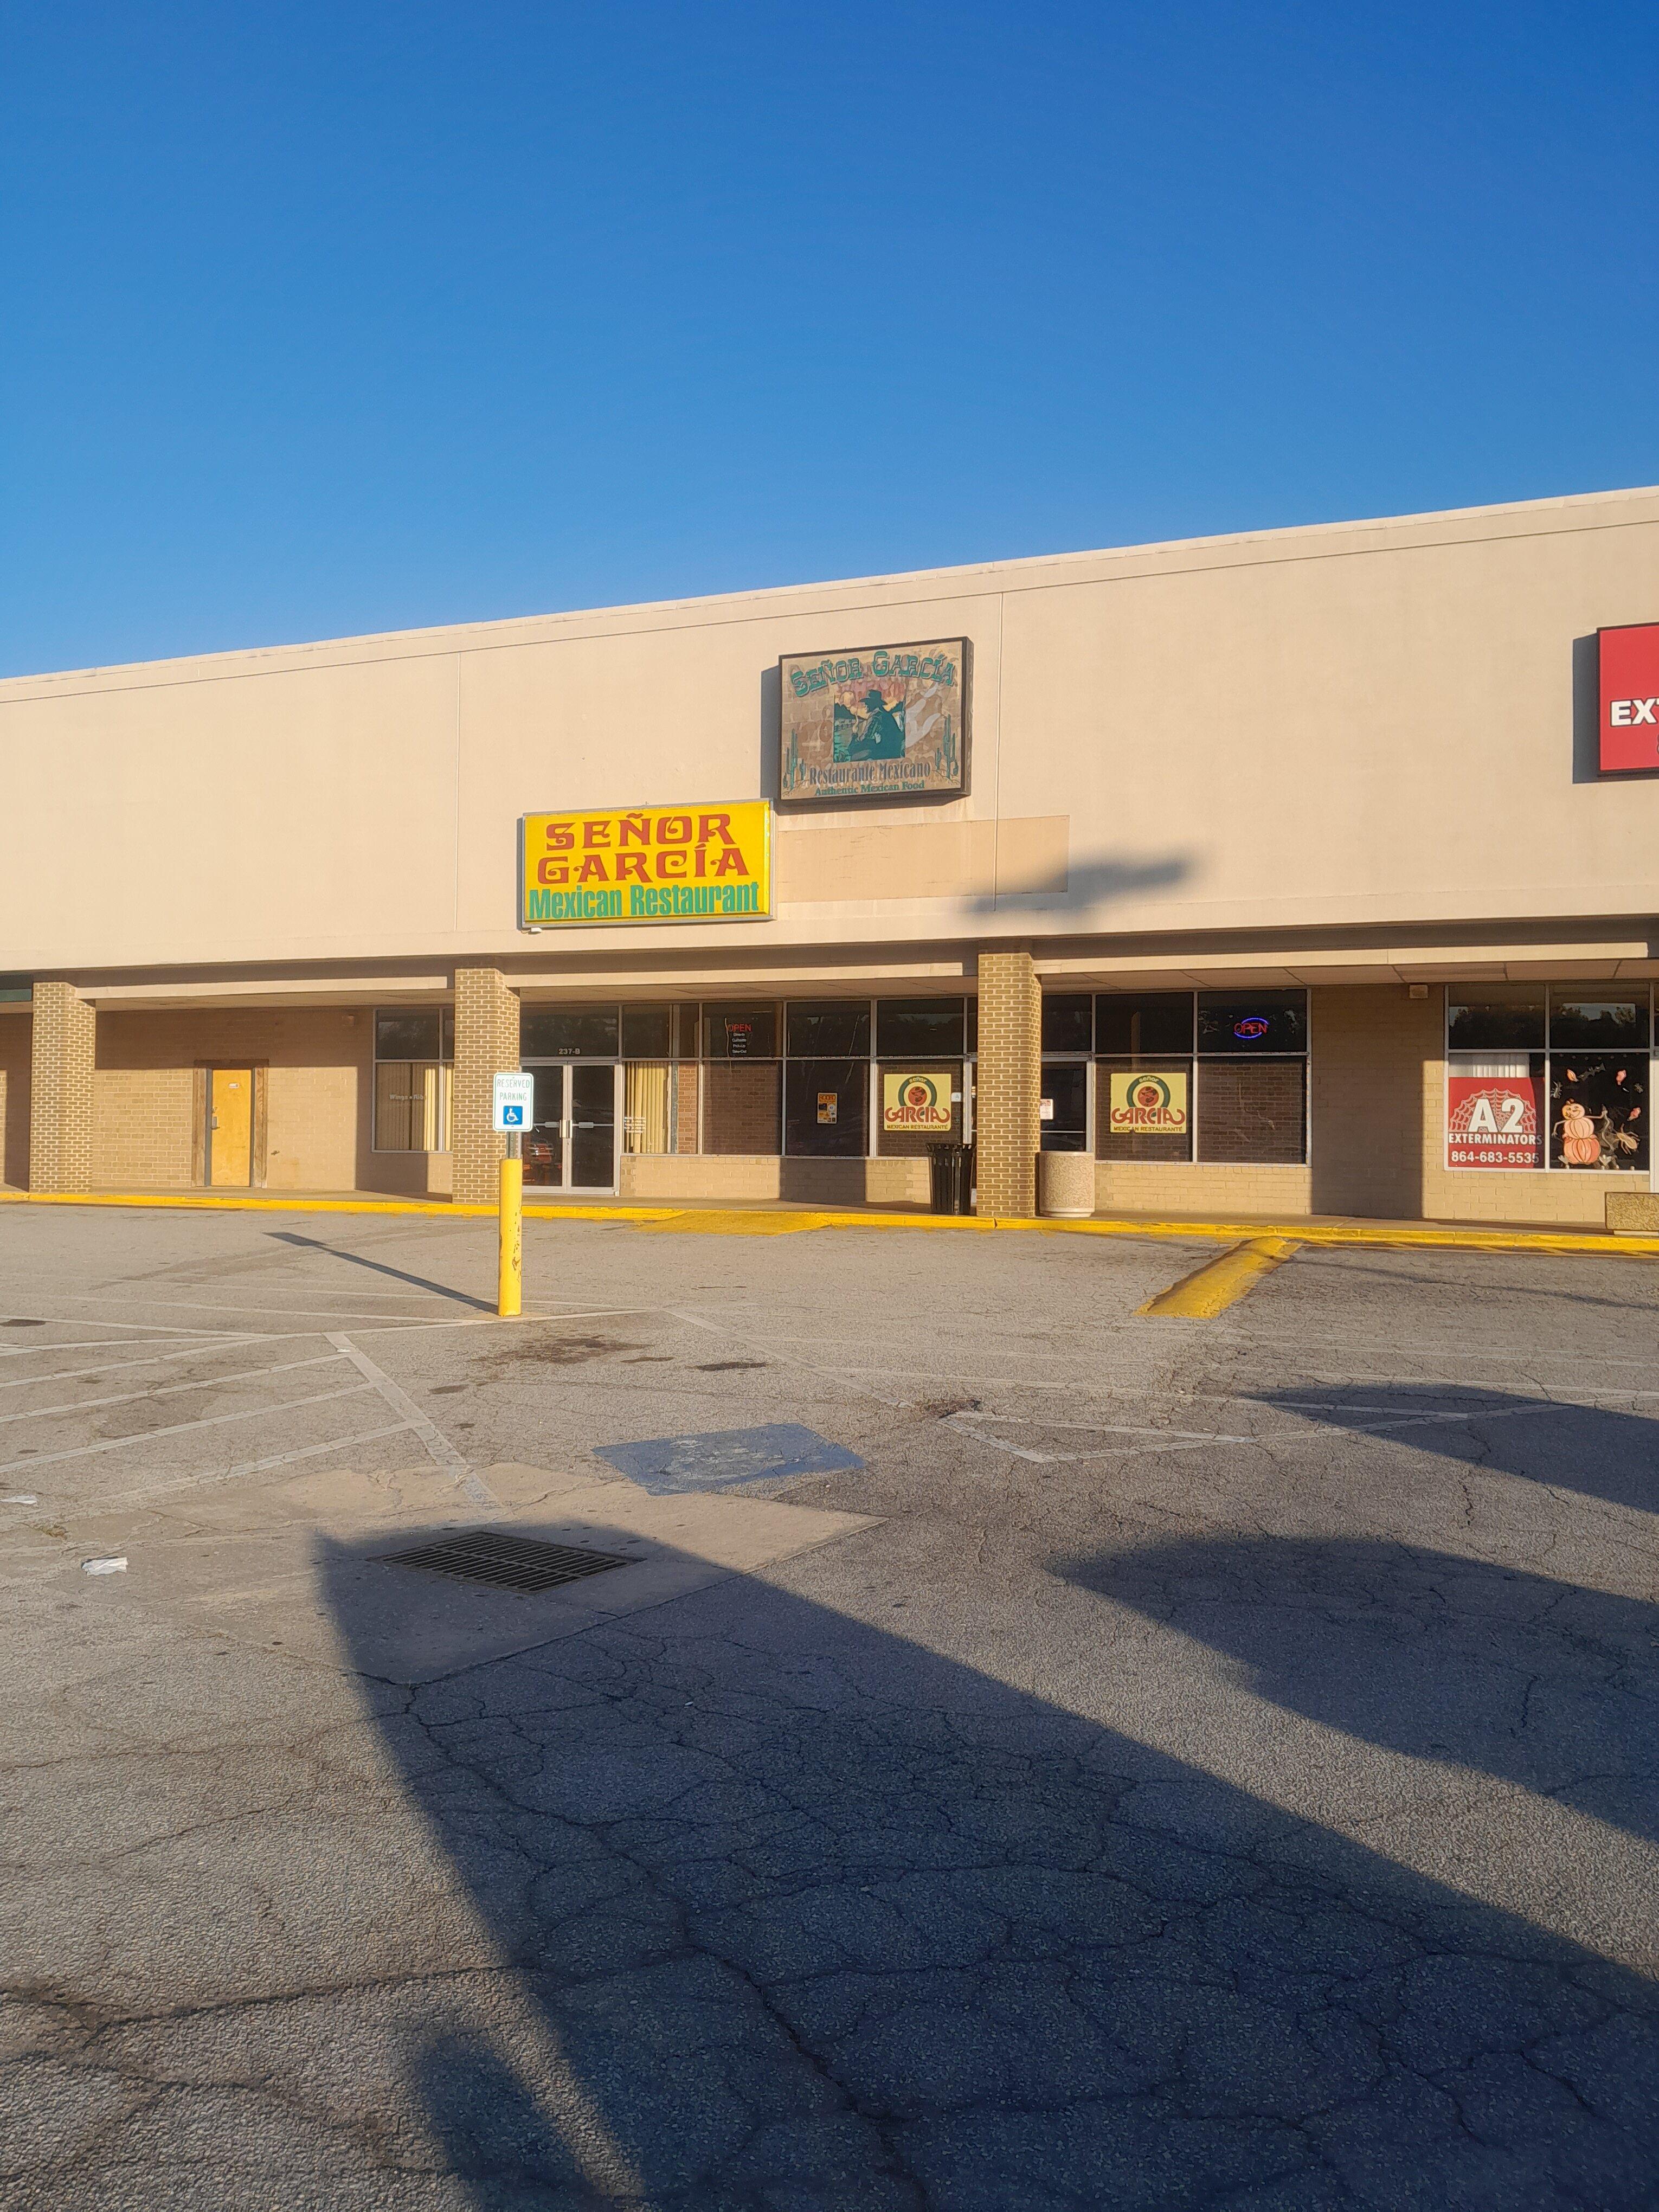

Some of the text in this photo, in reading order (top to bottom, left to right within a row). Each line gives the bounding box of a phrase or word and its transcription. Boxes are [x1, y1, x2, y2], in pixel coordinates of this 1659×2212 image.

[791, 651, 956, 697] SEÑOR GARCÍA
[809, 761, 931, 785] Restaurante Mexicano
[815, 780, 925, 796] Authentic Mexican Food
[546, 813, 736, 851] SEÑOR
[538, 843, 750, 884] GARCÍA
[529, 885, 622, 919] Mexican
[630, 881, 758, 915] Restaurant
[727, 1024, 752, 1032] OPEN
[1234, 1023, 1267, 1034] OPEN
[497, 1079, 530, 1088] RESERVED
[499, 1092, 527, 1101] PARKING
[885, 1106, 950, 1123] GARCIA
[1111, 1107, 1185, 1125] GARCIA
[1467, 1098, 1525, 1133] A2
[1449, 1133, 1543, 1145] EXTERMINATORS
[1451, 1150, 1540, 1164] 864-683-5535
